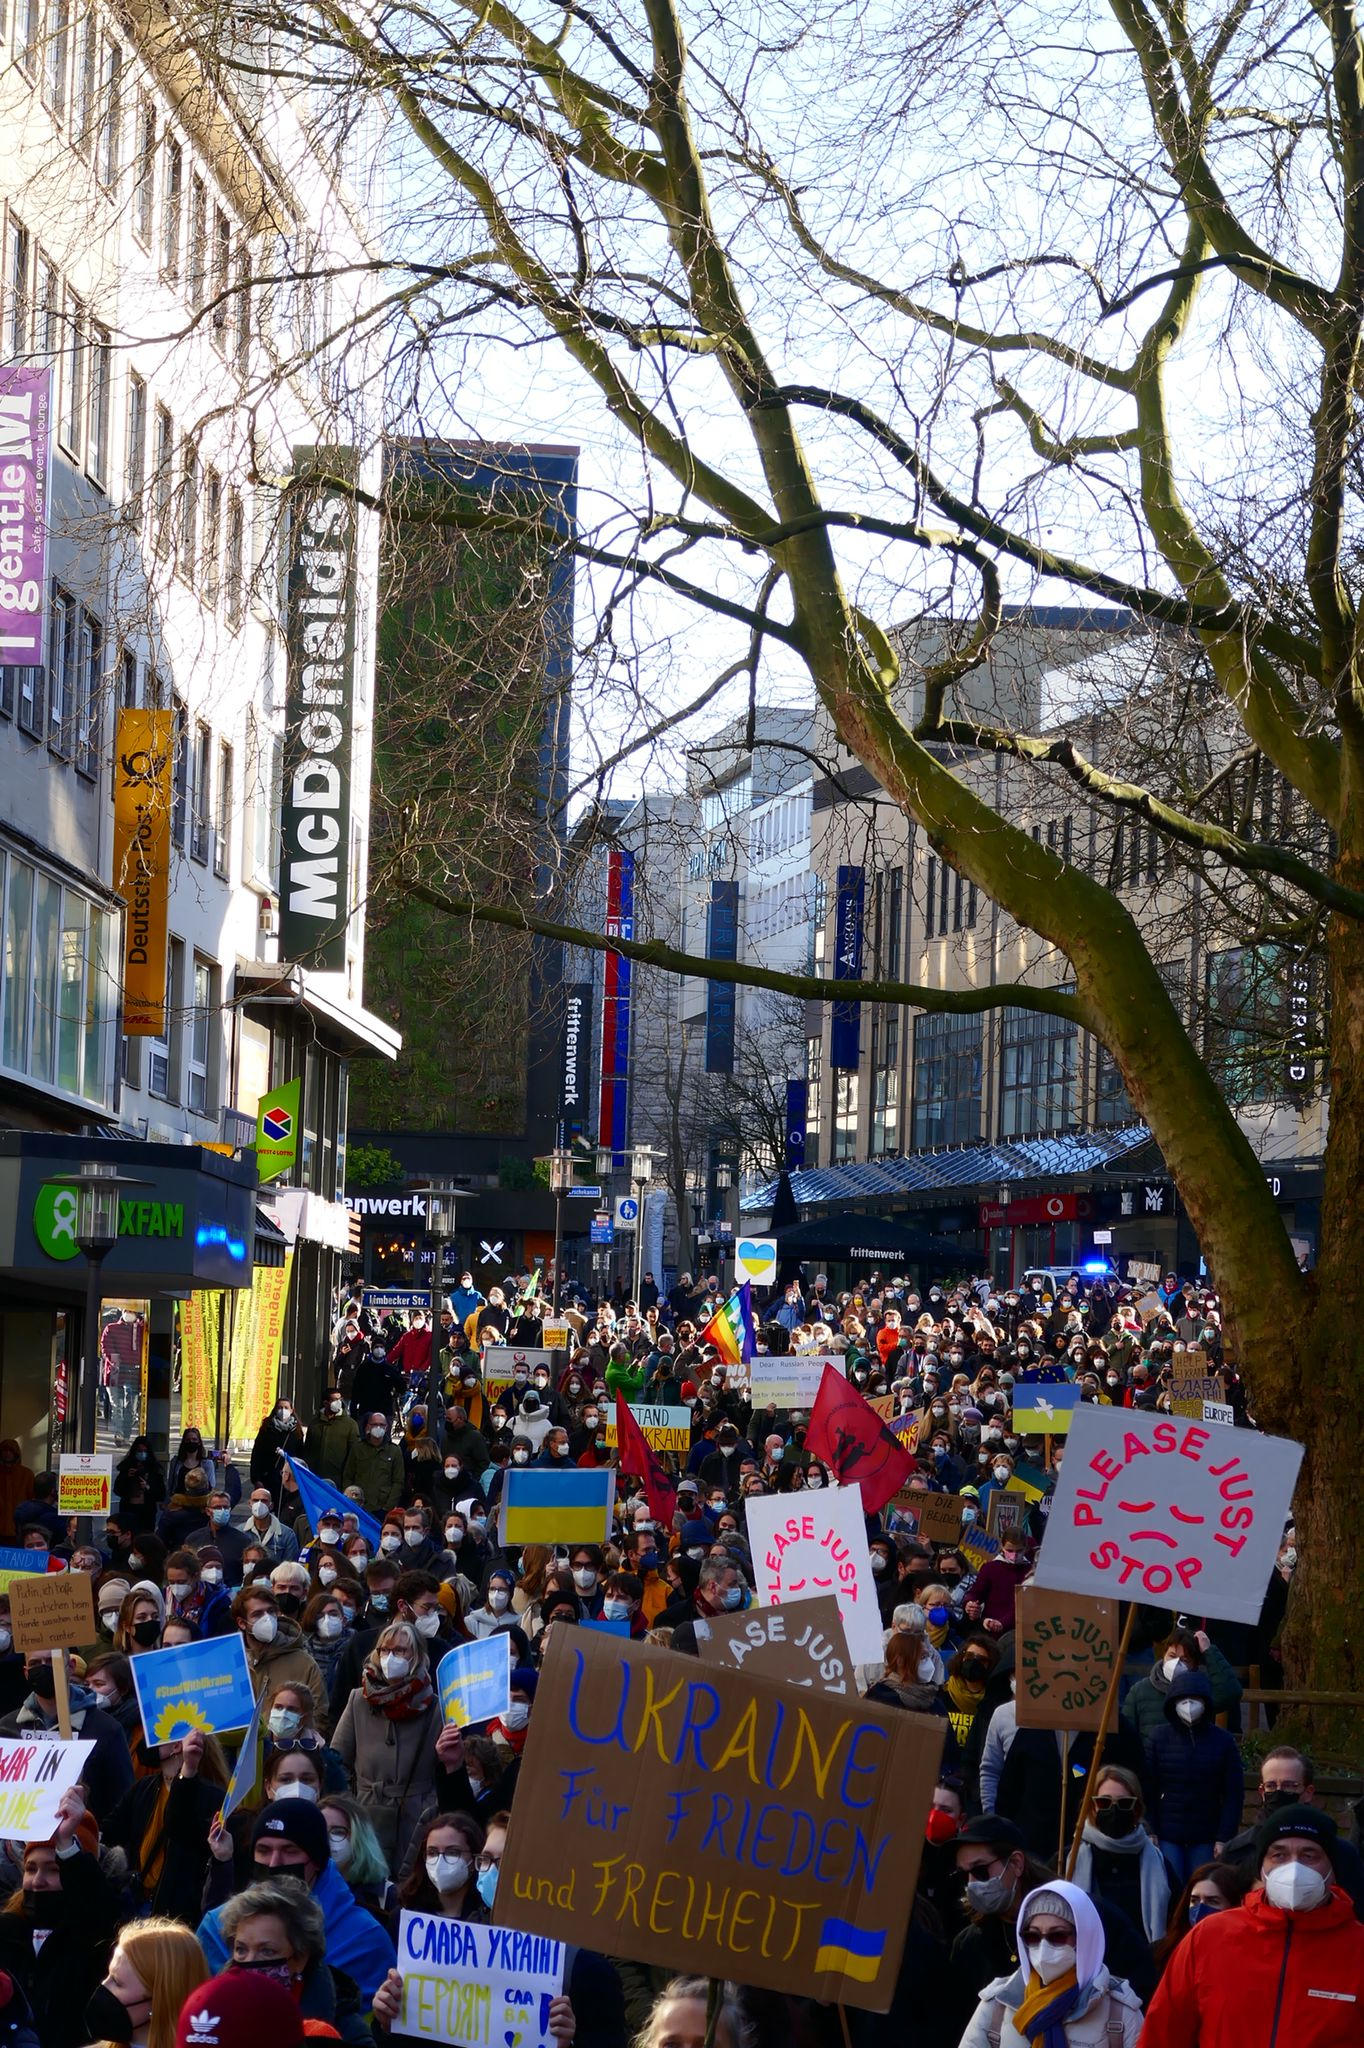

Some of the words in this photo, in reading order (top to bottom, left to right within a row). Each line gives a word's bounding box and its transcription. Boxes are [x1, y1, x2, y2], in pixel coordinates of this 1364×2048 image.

[288, 498, 349, 920] McDonald's
[132, 803, 153, 852] Post
[128, 859, 151, 965] Deutsche
[711, 908, 732, 1037] PRIARK
[565, 998, 582, 1105] frittenwerk
[119, 1201, 185, 1238] XFAM
[343, 1195, 427, 1216] enwerk
[1145, 1186, 1163, 1212] WMF
[850, 1247, 905, 1260] frittenwerk
[369, 1294, 411, 1305] Limbecker
[412, 1294, 428, 1306] Str.
[726, 1364, 746, 1377] NO
[730, 1377, 751, 1389] WA
[780, 1360, 804, 1368] Russian
[1205, 1407, 1233, 1424] EUROPE
[642, 1428, 690, 1449] KRAINE
[60, 1475, 101, 1486] Kostenloser
[1073, 1422, 1211, 1526] PLEASE
[1208, 1457, 1254, 1558] JUST
[926, 1510, 962, 1526] BEIDEN
[934, 1496, 953, 1509] DIE
[820, 1529, 858, 1603] JUST
[1090, 1541, 1204, 1594] STOP
[1022, 1616, 1066, 1699] PLEASE
[1071, 1616, 1114, 1670] JUST
[1062, 1675, 1108, 1711] STOP
[567, 1647, 889, 1809] UKRAINE
[559, 1766, 630, 1834] Für
[666, 1787, 893, 1894] FRIEDEN
[513, 1868, 576, 1911] und
[592, 1853, 822, 1962] FREIHEIT
[406, 1917, 478, 1968] СЛАВА
[401, 1972, 493, 2046] ГЕРОЯМ
[186, 2033, 219, 2045] adidas
